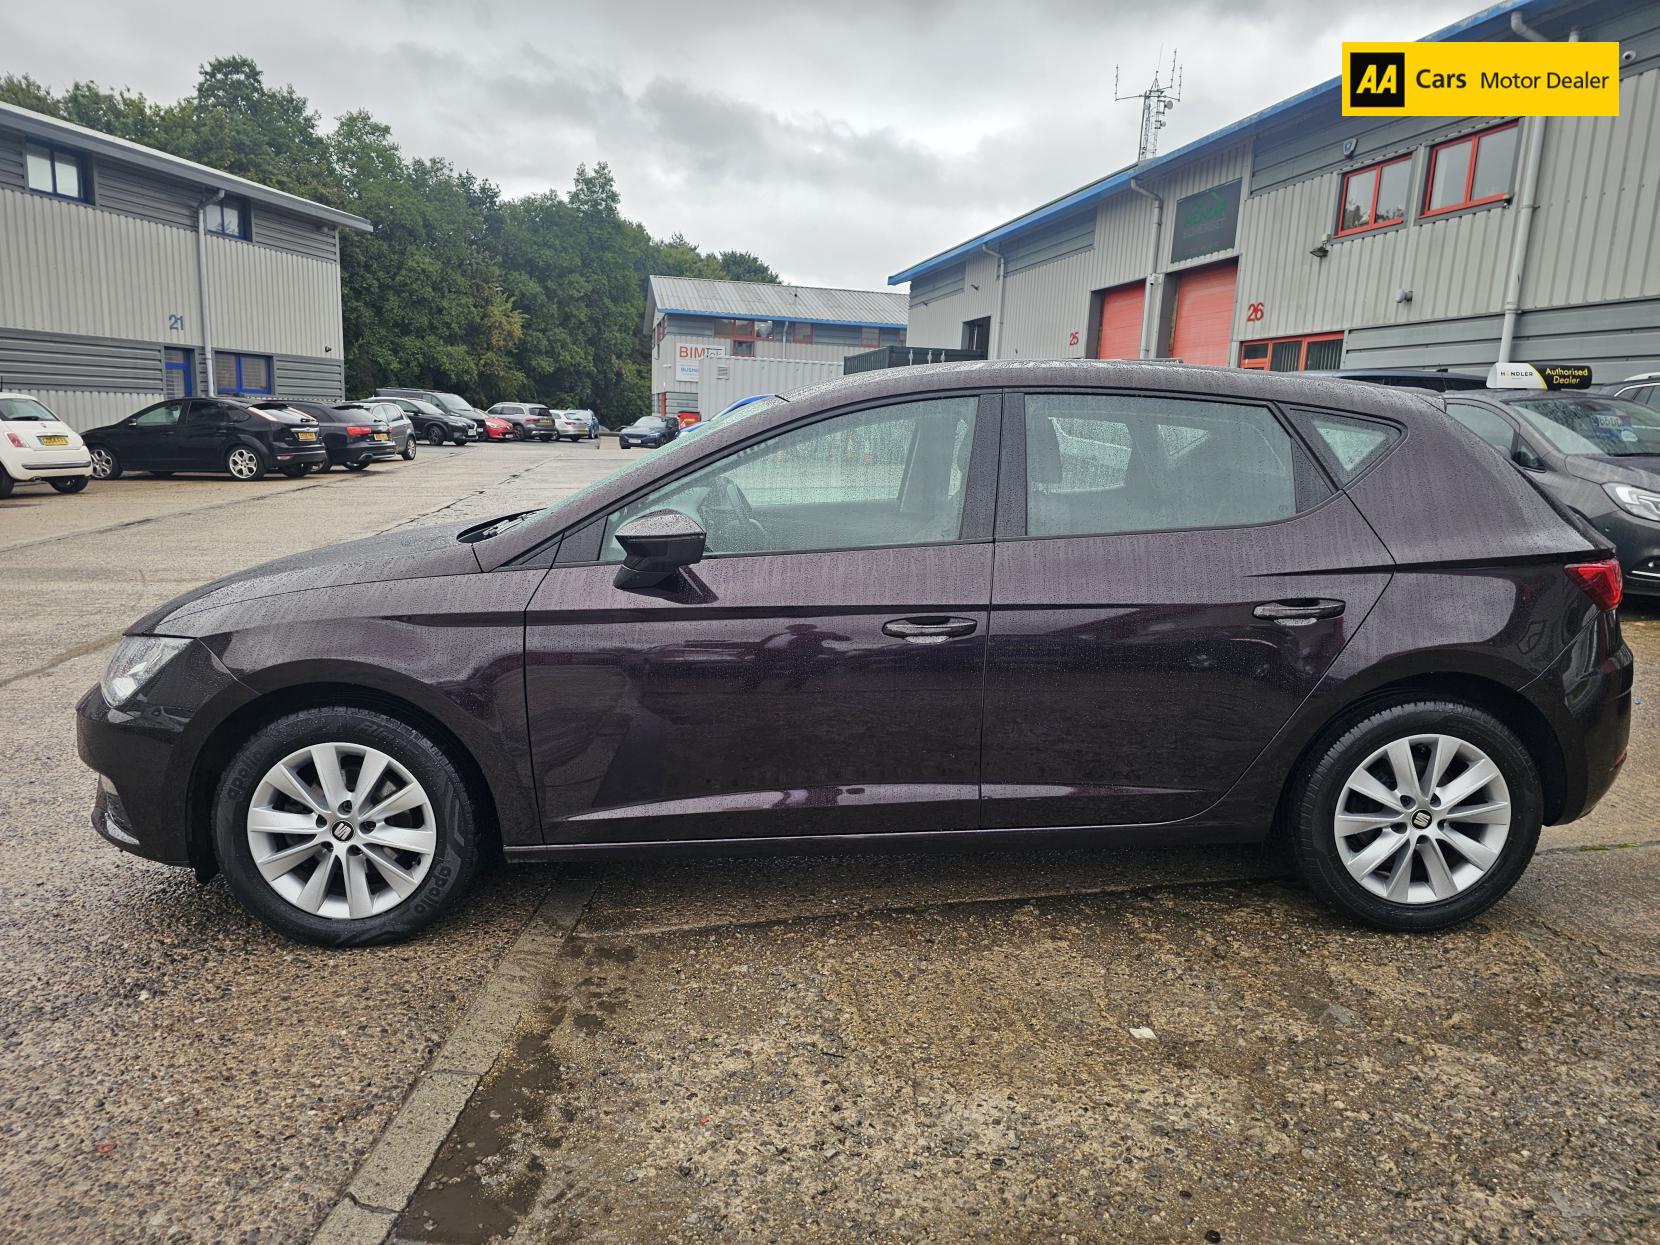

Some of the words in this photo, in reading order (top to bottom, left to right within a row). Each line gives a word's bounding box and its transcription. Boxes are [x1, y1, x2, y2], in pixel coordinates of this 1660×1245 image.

[1247, 302, 1264, 322] 26
[169, 314, 184, 331] 21
[1069, 332, 1079, 346] 25
[1545, 367, 1588, 376] Authorised
[1553, 376, 1580, 384] Dealer
[414, 862, 453, 914] apollo
